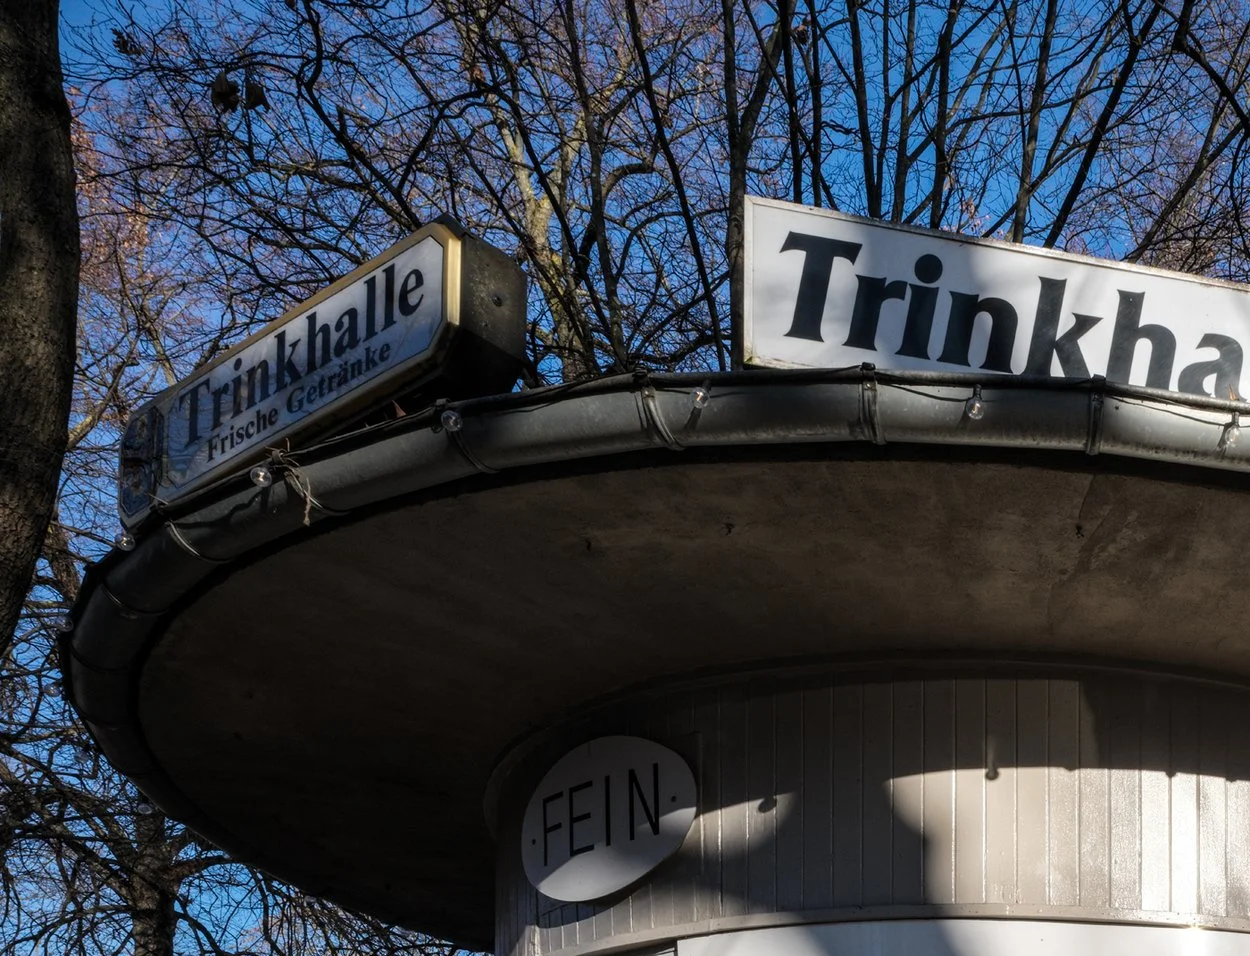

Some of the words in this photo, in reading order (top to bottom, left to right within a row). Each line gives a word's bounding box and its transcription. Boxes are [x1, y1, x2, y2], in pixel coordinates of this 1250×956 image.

[179, 263, 424, 449] Trinkhalle
[207, 407, 279, 463] Frische
[286, 343, 391, 414] Getränke
[543, 763, 660, 867] FEIN
